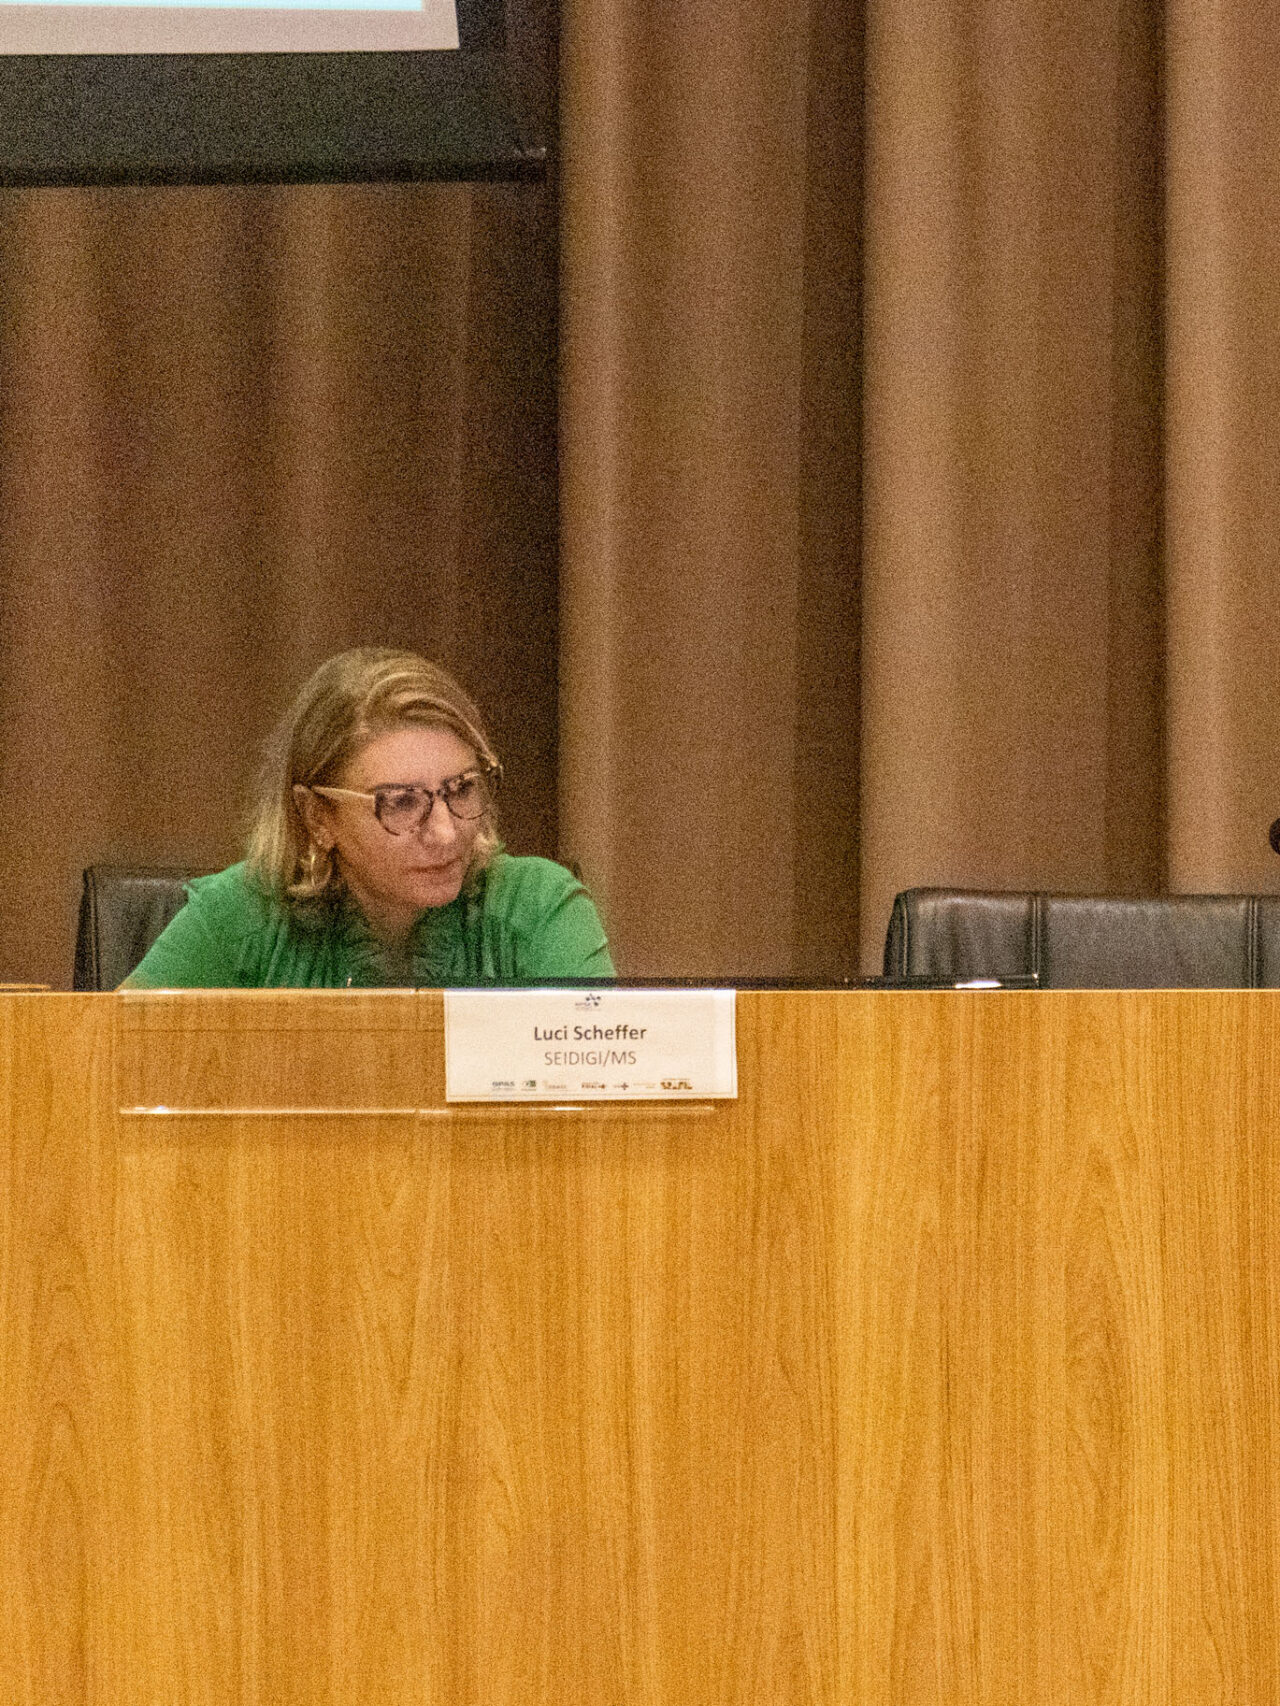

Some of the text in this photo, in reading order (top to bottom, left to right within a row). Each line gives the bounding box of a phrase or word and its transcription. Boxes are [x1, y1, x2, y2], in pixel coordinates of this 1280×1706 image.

[533, 1025, 647, 1042] Luci Scheffer
[544, 1050, 637, 1068] SEIDIGI/MS
